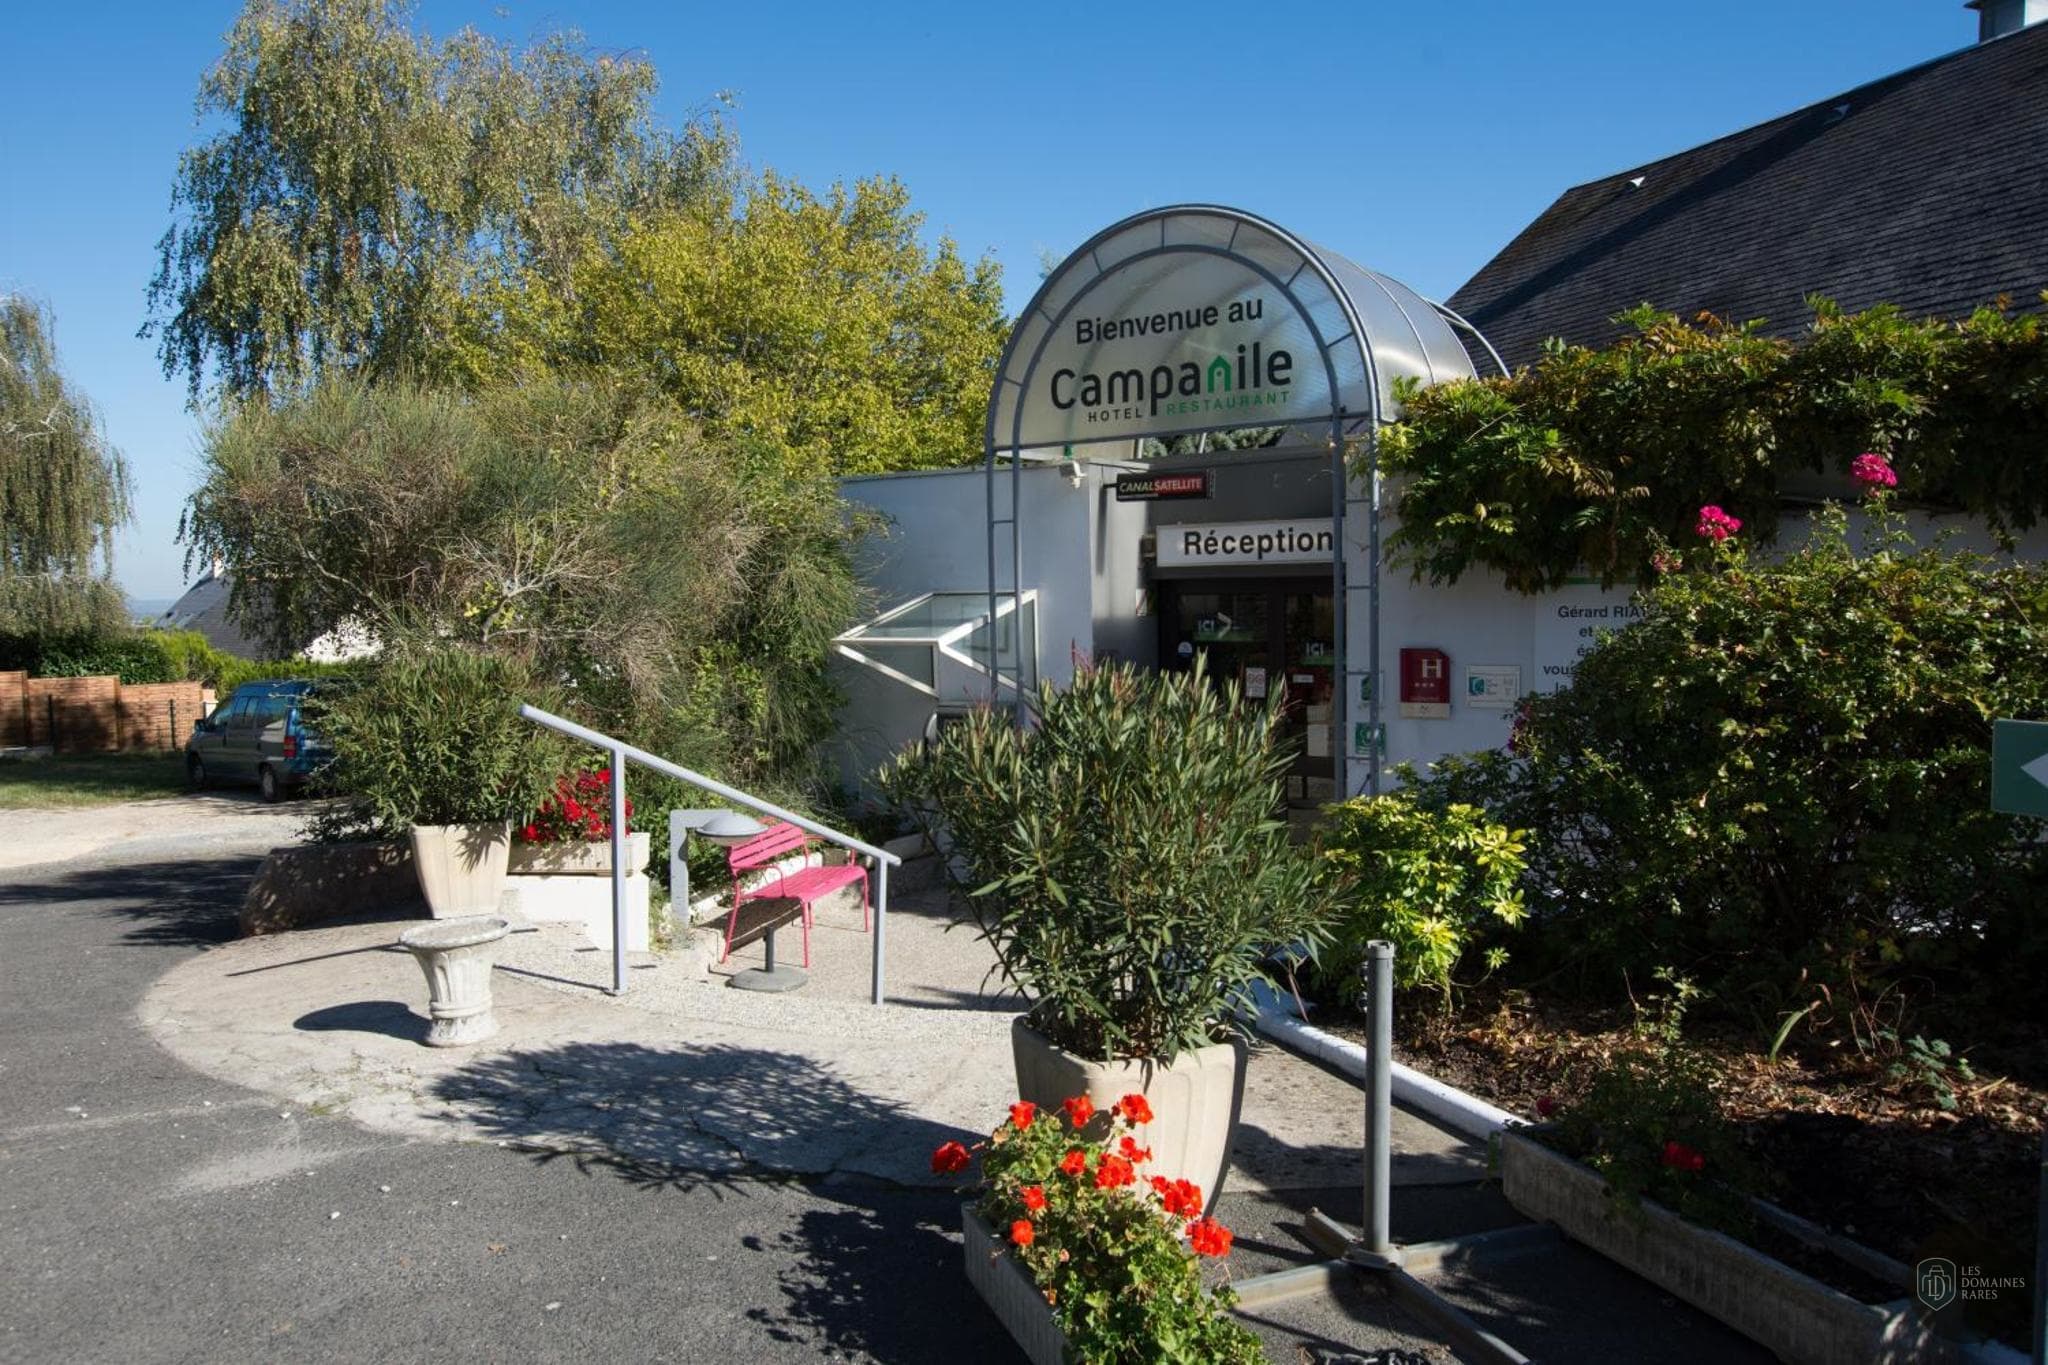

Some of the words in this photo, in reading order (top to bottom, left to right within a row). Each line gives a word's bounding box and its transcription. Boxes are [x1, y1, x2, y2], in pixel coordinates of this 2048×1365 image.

[1076, 306, 1218, 345] Bienvenue
[1228, 298, 1263, 323] au
[1050, 341, 1293, 417] Campanile
[1088, 408, 1143, 422] HOTEL
[1166, 391, 1291, 416] RESTAURANT
[1184, 527, 1333, 560] Réception
[1557, 605, 1608, 619] Gérard
[1580, 626, 1593, 638] et
[1422, 658, 1442, 678] H
